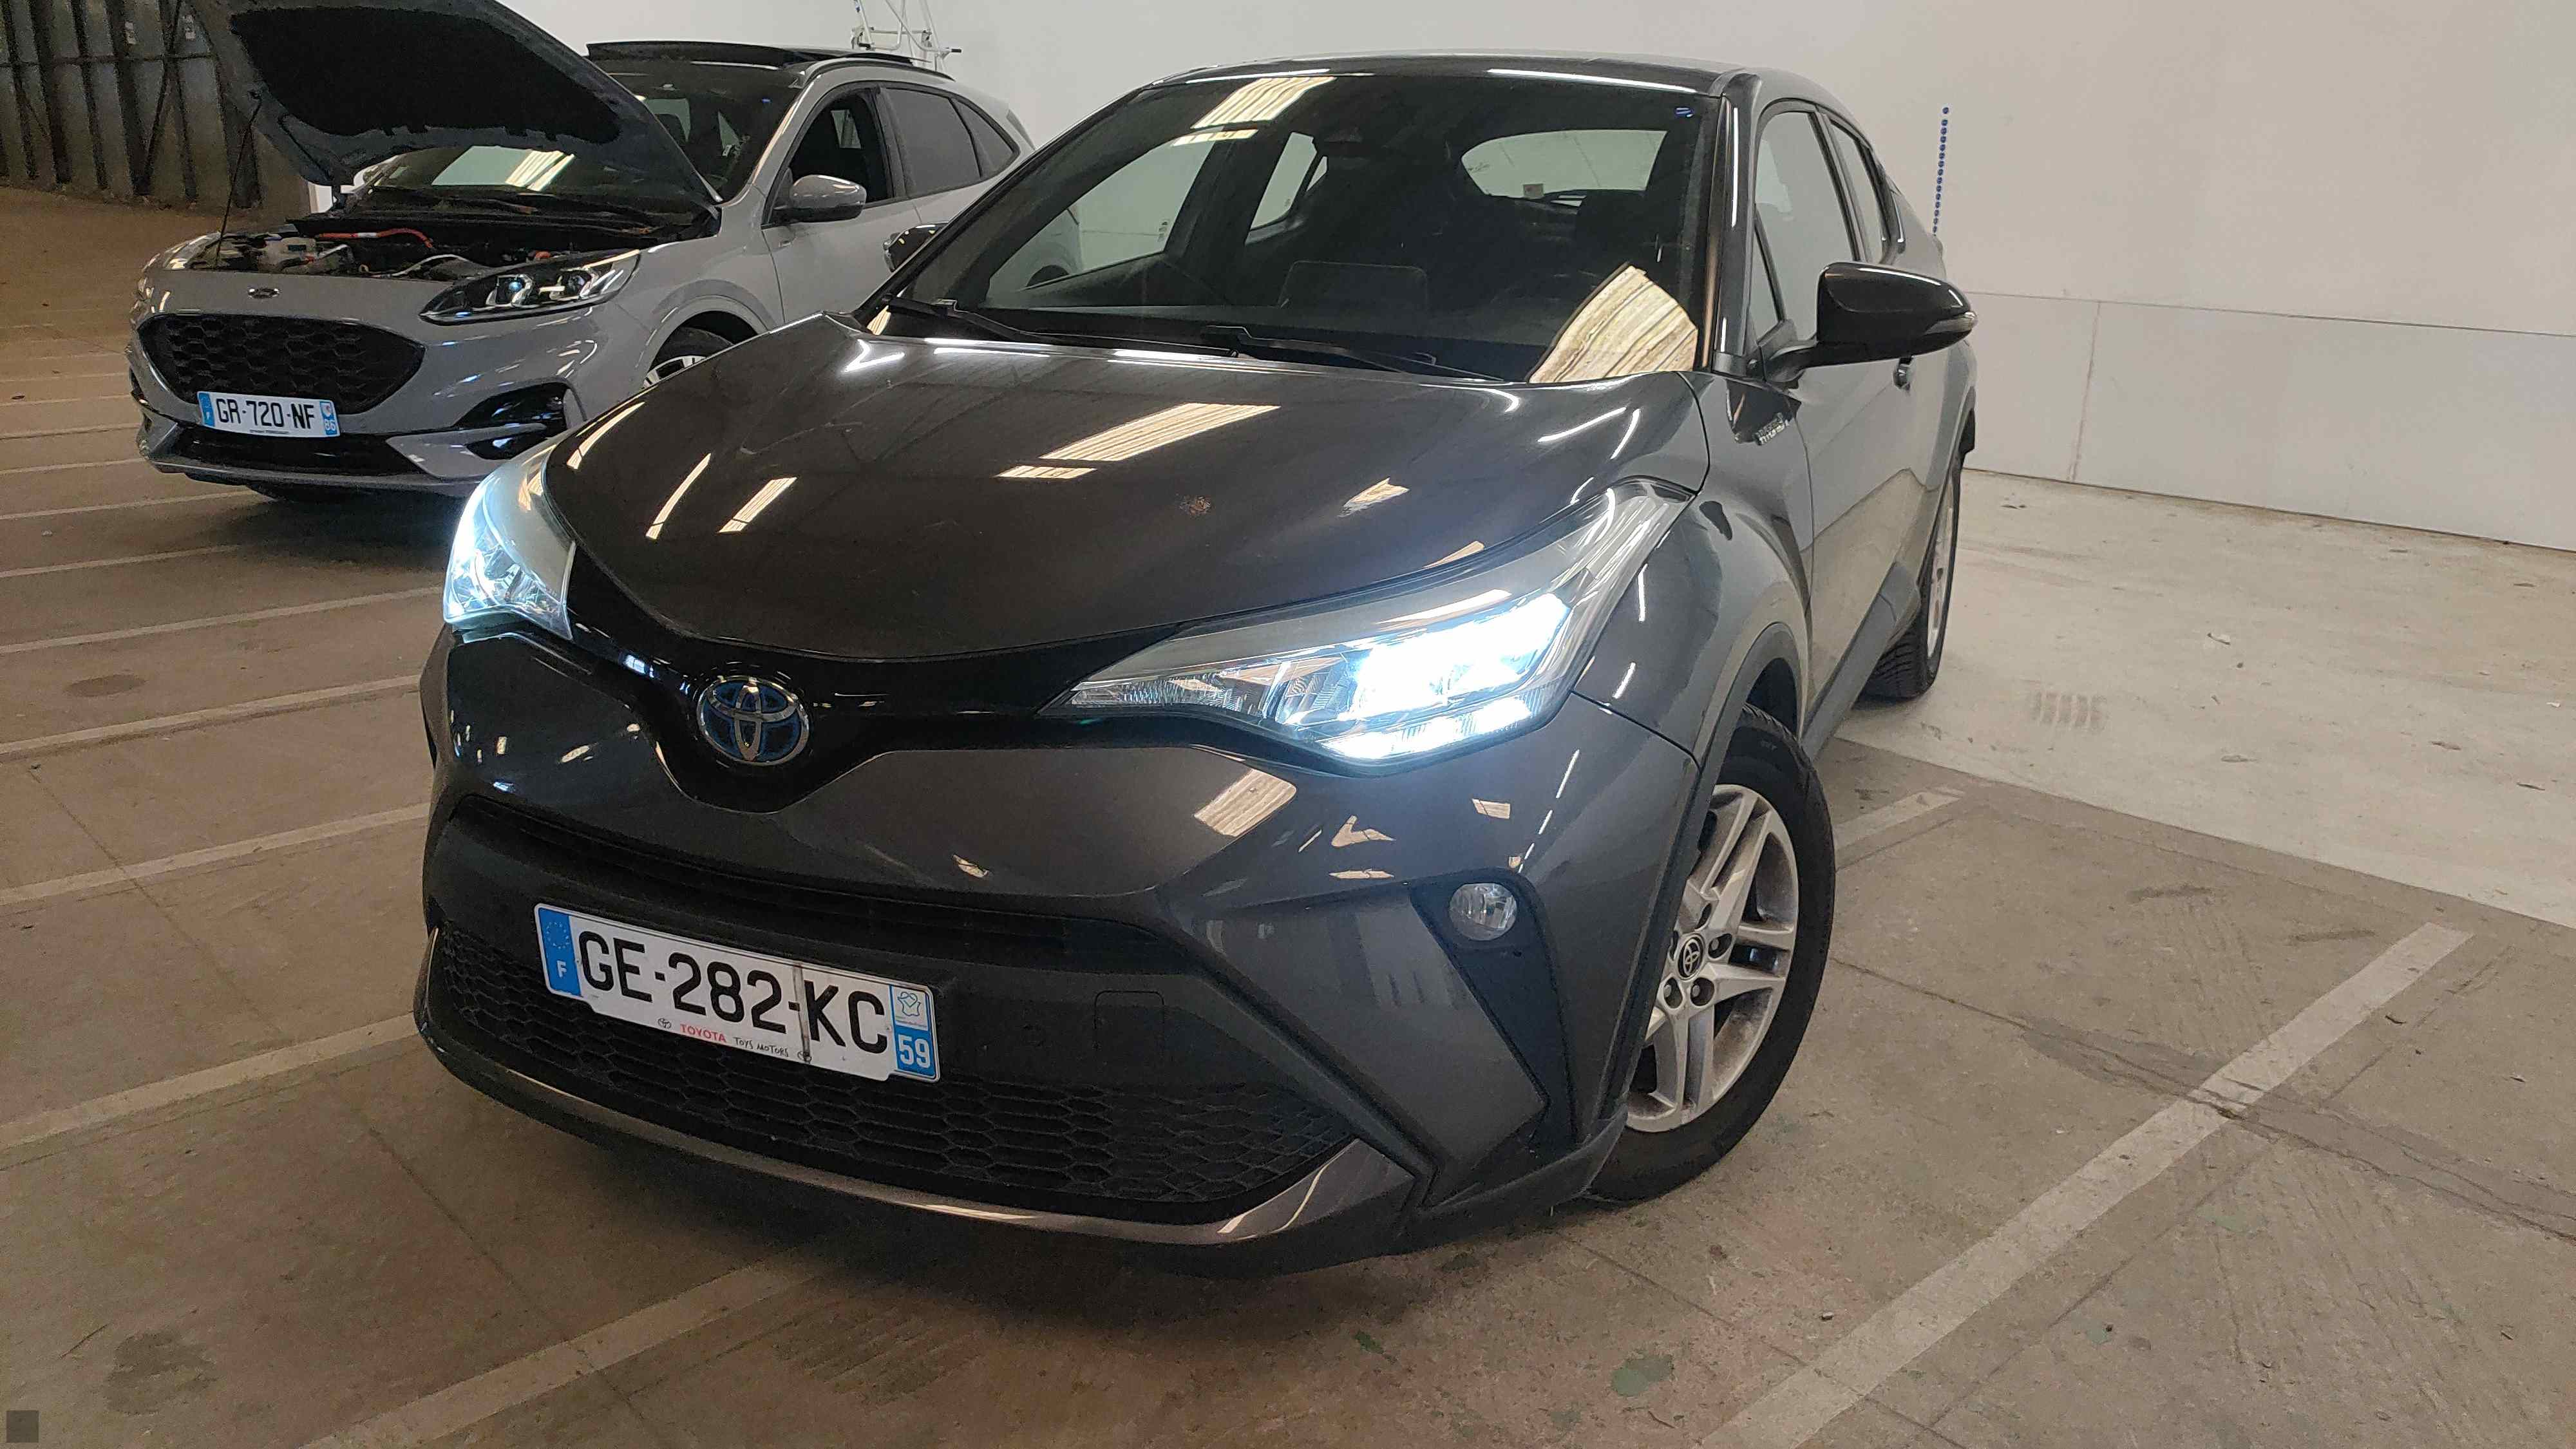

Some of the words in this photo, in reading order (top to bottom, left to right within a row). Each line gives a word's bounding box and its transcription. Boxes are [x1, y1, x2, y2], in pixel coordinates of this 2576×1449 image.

[216, 398, 315, 429] GR-720-NF
[556, 960, 567, 978] F
[578, 931, 888, 1054] GE-282-KC
[680, 1024, 726, 1043] TOYOTA
[757, 1044, 789, 1057] MOTORS
[898, 1034, 931, 1069] 59
